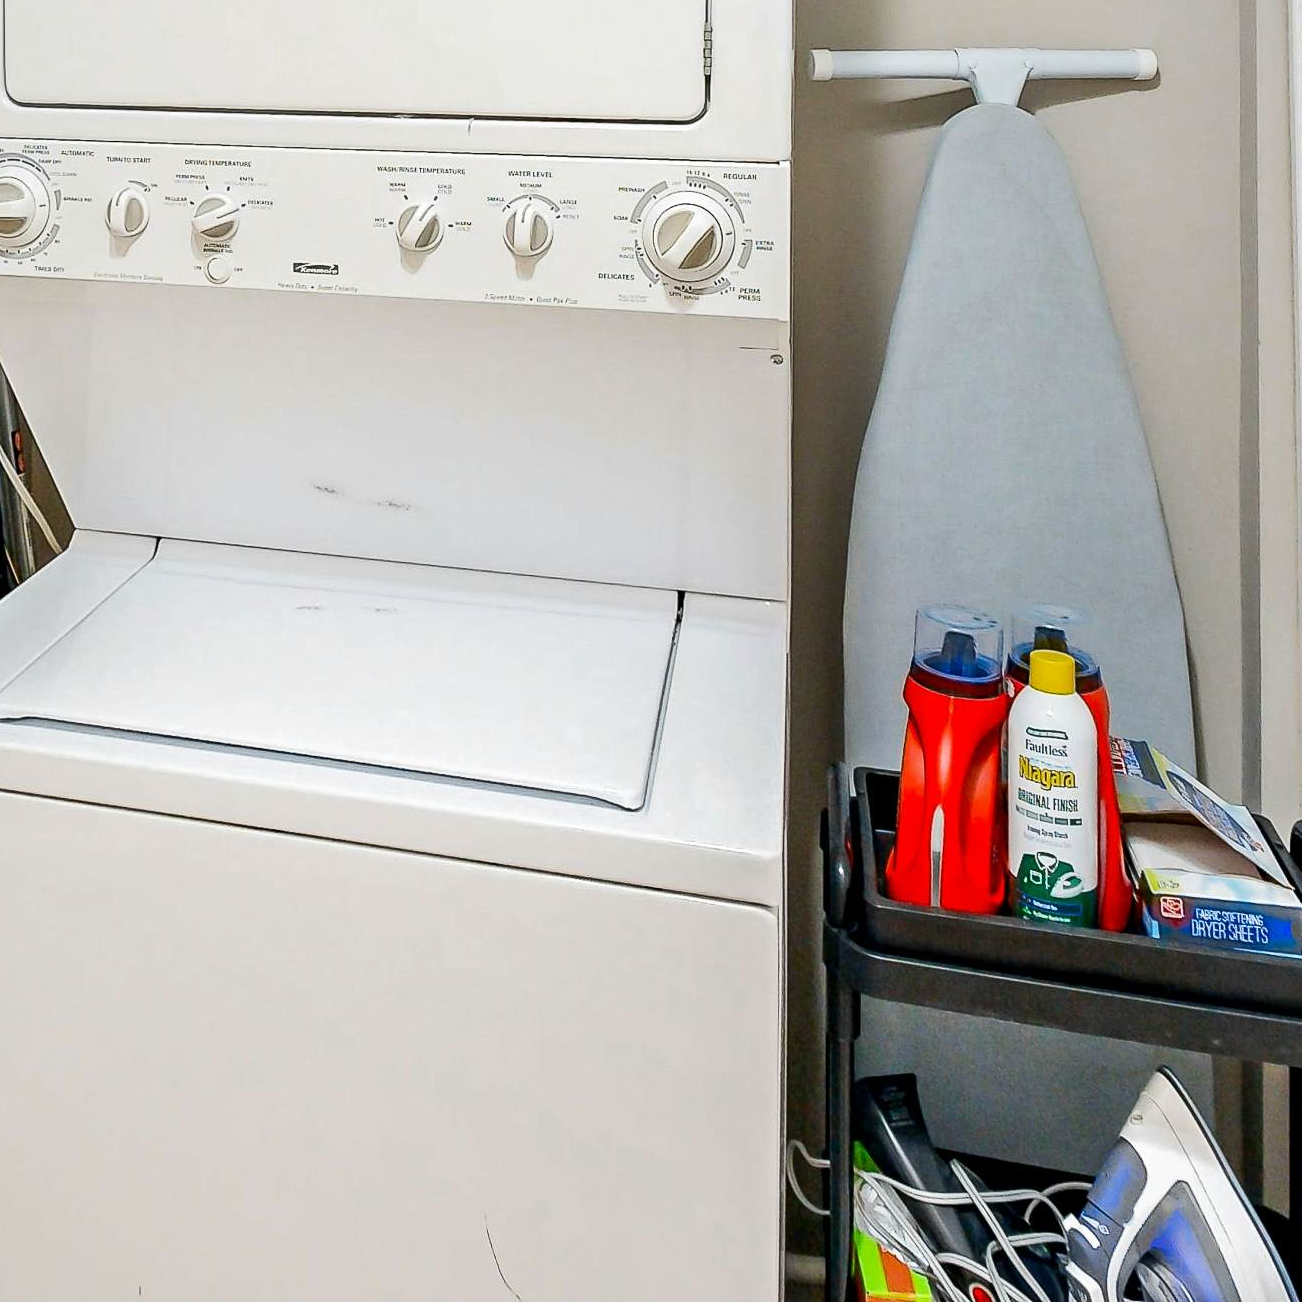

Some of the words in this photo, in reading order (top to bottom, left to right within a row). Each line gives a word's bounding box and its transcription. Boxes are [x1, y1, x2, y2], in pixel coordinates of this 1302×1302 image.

[184, 159, 208, 167] DRYING
[208, 159, 252, 168] TEMPERATURE
[377, 166, 417, 174] WASH/RINSE
[418, 167, 466, 175] TEMPERATURE
[723, 172, 757, 181] REGULAR
[300, 266, 338, 275] Kenmore
[598, 272, 635, 281] DELICATES
[738, 294, 761, 302] PRESS
[1025, 738, 1068, 757] Faultless
[1018, 754, 1077, 791] Niagara
[1017, 787, 1050, 810] ORIGINAL
[1053, 798, 1078, 813] FINISH
[1195, 908, 1222, 921] FABRIC
[1222, 911, 1264, 926] SOFTENING
[1191, 919, 1227, 940] DRYER
[1228, 922, 1269, 944] SHEETS
